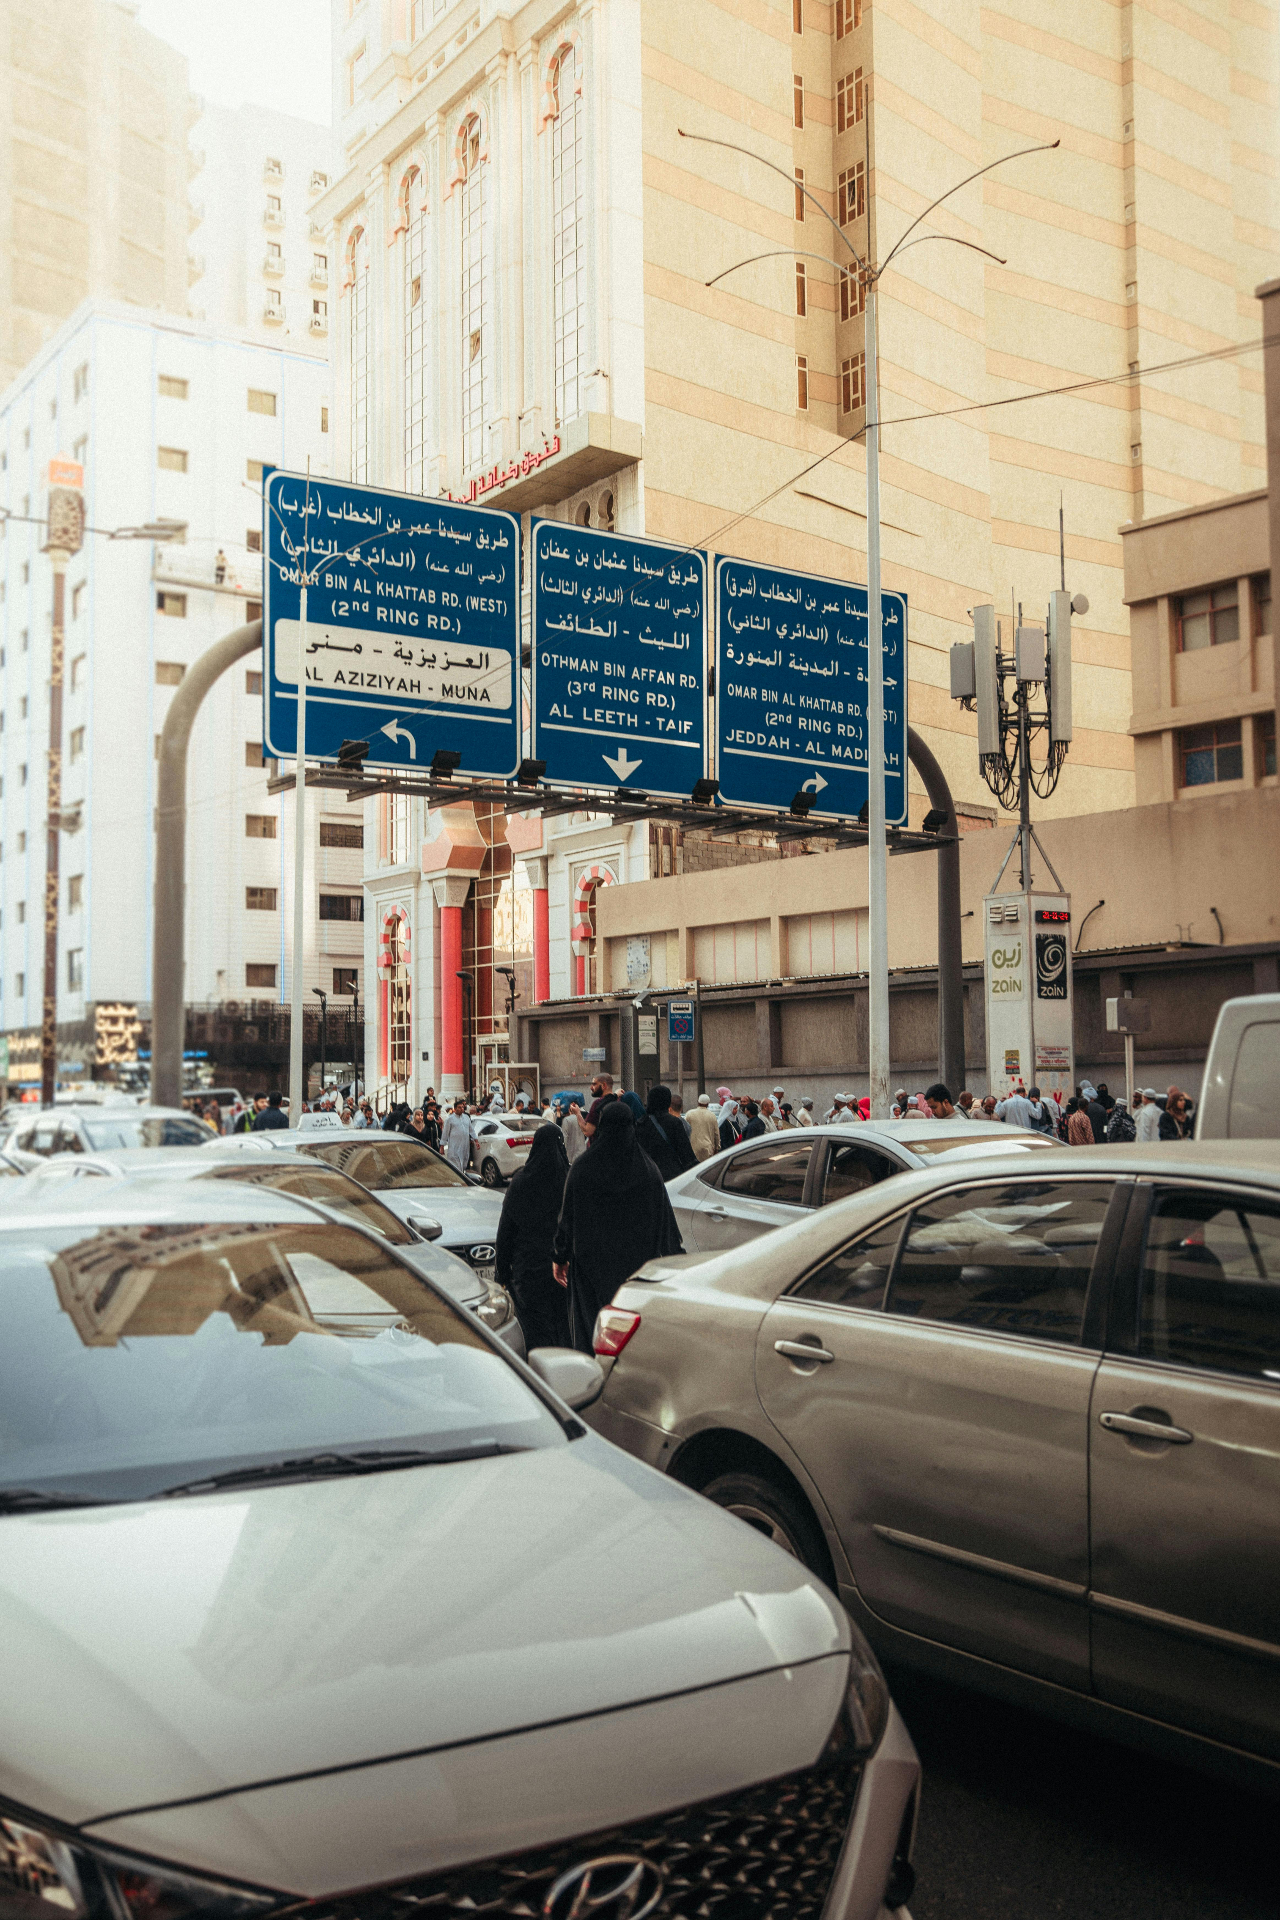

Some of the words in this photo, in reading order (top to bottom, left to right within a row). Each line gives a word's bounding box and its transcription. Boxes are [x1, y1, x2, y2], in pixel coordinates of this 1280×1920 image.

[520, 434, 560, 476] فندق
[478, 459, 519, 495] ضيافة
[278, 483, 322, 520] (غرب)
[326, 500, 382, 525] الخطاب
[386, 513, 401, 534] بن
[407, 522, 432, 537] عمر
[438, 518, 472, 544] سيدنا
[280, 526, 338, 562] الثاني)
[476, 528, 508, 551] طريق
[540, 538, 570, 560] عفان
[345, 547, 416, 572] (الدائري
[426, 552, 450, 573] عنه)
[454, 562, 473, 576] الله
[576, 548, 589, 568] بن
[593, 548, 628, 570] عثمان
[633, 554, 664, 579] سيدنا
[478, 564, 506, 584] (رضي
[540, 571, 578, 596] الثالث)
[668, 564, 698, 588] طريق
[726, 568, 756, 598] (شرق)
[280, 566, 320, 586] OMAR
[326, 573, 348, 591] BIN
[353, 578, 371, 594] AL
[376, 581, 436, 604] KHATTAB
[442, 591, 462, 608] RD.
[466, 595, 508, 617] (WEST)
[581, 584, 623, 607] (الدائري
[630, 588, 650, 608] عنه)
[654, 597, 670, 610] الله
[760, 582, 802, 604] الخطاب
[805, 594, 816, 612] بن
[332, 600, 369, 618] (2nd
[376, 606, 419, 627] RING
[428, 614, 461, 635] RD.)
[672, 600, 700, 619] (رضي
[728, 606, 770, 634] الثاني)
[821, 601, 840, 614] عمر
[545, 613, 617, 638] الطائف
[776, 624, 828, 645] (الدائري
[836, 628, 855, 646] عنه)
[638, 626, 690, 651] الليث
[393, 640, 490, 670] العزيزية
[726, 642, 782, 667] المنورة
[788, 652, 839, 677] المدينة
[541, 652, 599, 673] OTHMAN
[604, 662, 626, 678] BIN
[631, 666, 675, 686] AFFAN
[680, 674, 700, 690] RD.
[334, 670, 421, 694] AZIZIYAH
[442, 683, 491, 702] MUNA
[567, 680, 596, 697] (3rd
[602, 685, 640, 704] RING
[646, 691, 676, 712] RD.)
[727, 683, 757, 700] OMAR
[762, 688, 778, 703] BIN
[782, 692, 795, 706] AL
[800, 695, 844, 714] KHATTAB
[848, 703, 862, 717] RD.
[866, 706, 897, 725] (ST)
[549, 703, 573, 719] AL
[583, 707, 638, 728] LEETH
[656, 717, 693, 734] TAIF
[765, 712, 792, 727] (2nd
[798, 717, 831, 734] RING
[837, 723, 863, 741] RD.)
[726, 729, 789, 750] JEDDAH
[805, 741, 825, 755] AL
[992, 942, 1022, 969] زين
